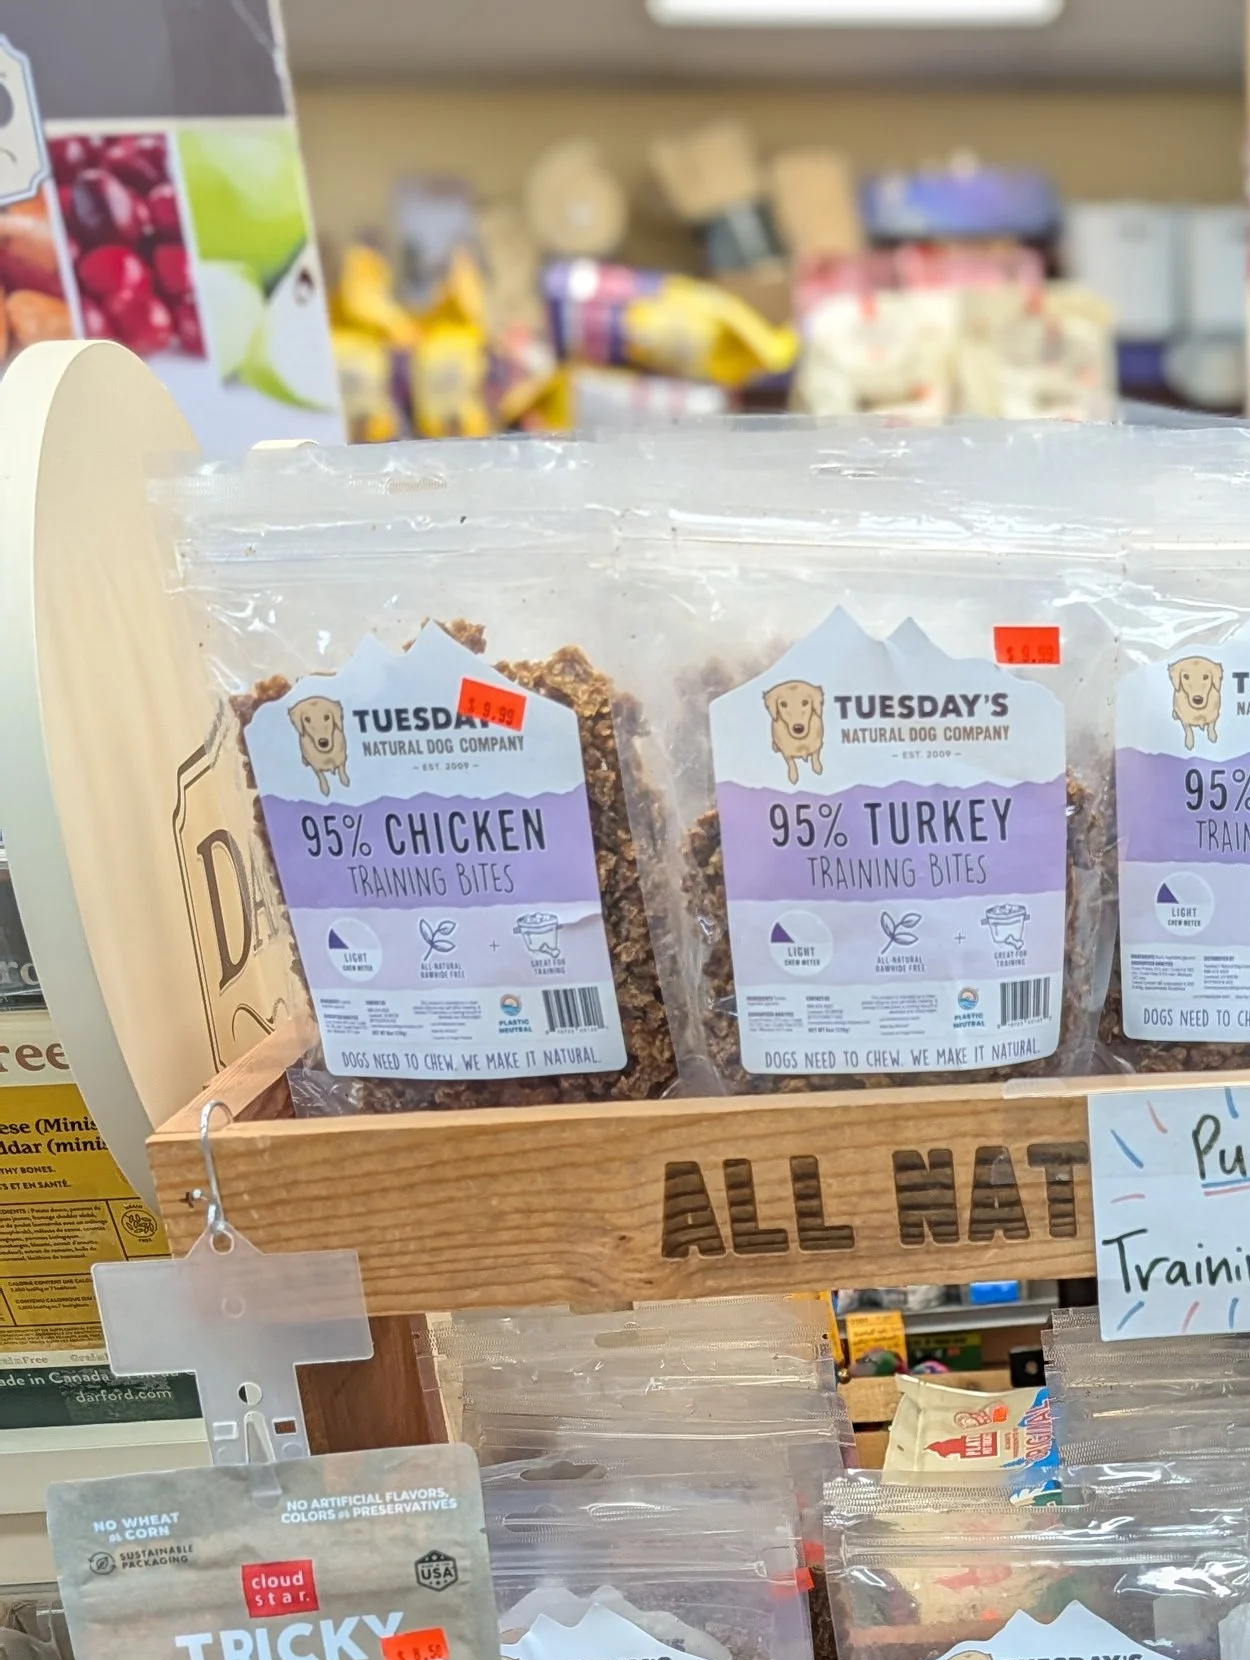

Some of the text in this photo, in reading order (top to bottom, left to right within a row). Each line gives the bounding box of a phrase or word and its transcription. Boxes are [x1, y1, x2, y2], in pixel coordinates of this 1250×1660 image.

[834, 692, 1009, 720] TUESDAY'S
[841, 725, 1010, 744] NATURAL DOG COMPANY
[926, 750, 951, 759] 2009
[301, 808, 546, 858] 95% CHICKEN
[769, 798, 1012, 848] 95% TURKEY
[348, 863, 515, 898] TRAINING BITES
[787, 947, 815, 957] LIGHT
[765, 1051, 797, 1070] DOGS
[805, 1050, 835, 1070] NEED
[843, 1050, 859, 1068] TO
[911, 1048, 929, 1067] WE
[937, 1046, 967, 1066] MAKE
[974, 1045, 984, 1061] IT
[661, 1155, 855, 1259] ALL
[76, 1388, 172, 1403] darford.com
[251, 1570, 304, 1591] cloud
